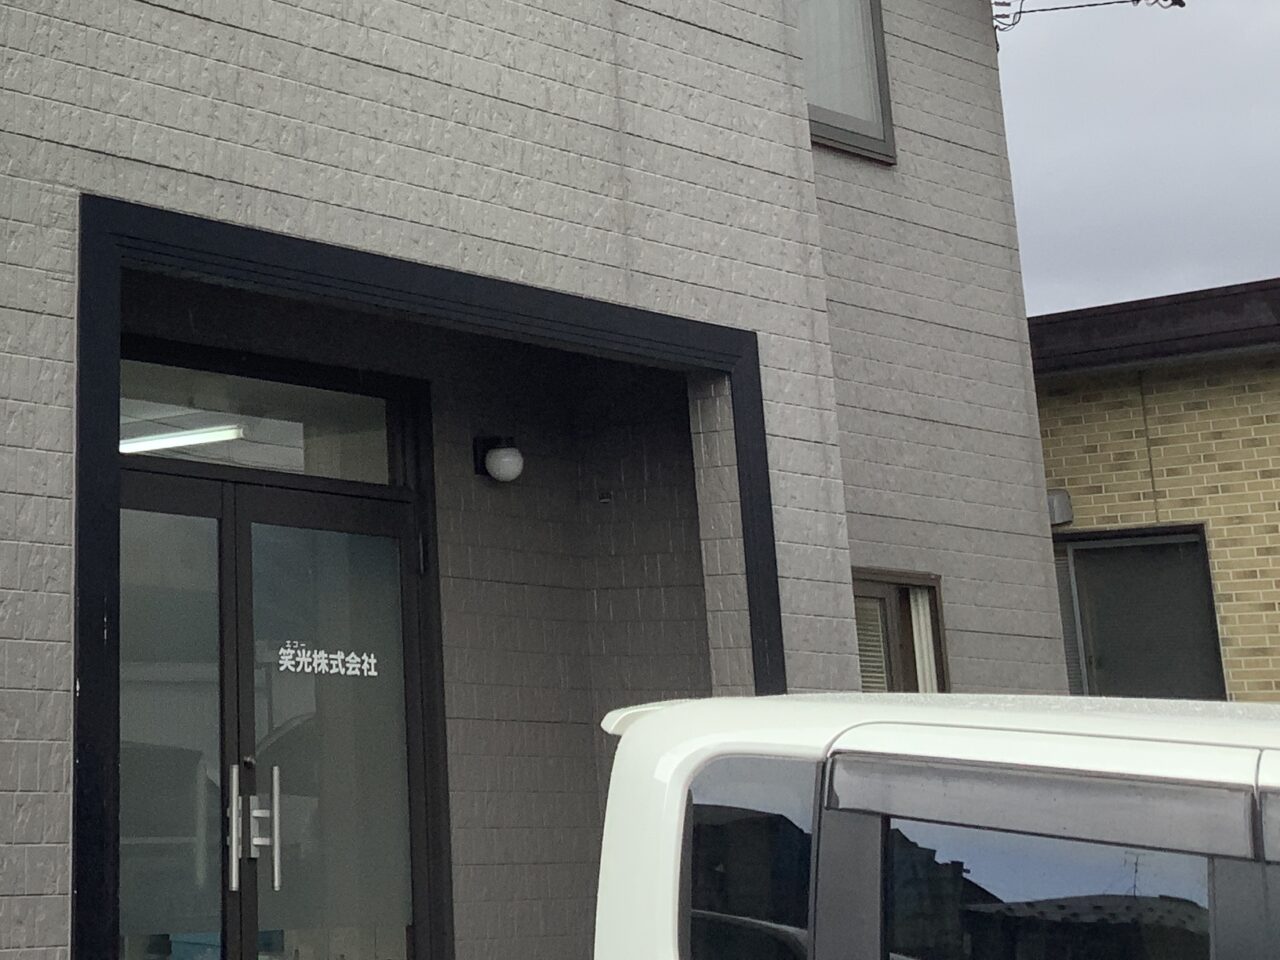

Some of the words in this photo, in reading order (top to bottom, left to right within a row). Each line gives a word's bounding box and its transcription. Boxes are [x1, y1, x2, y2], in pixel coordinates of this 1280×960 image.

[278, 646, 378, 677] 笑光株式会社
